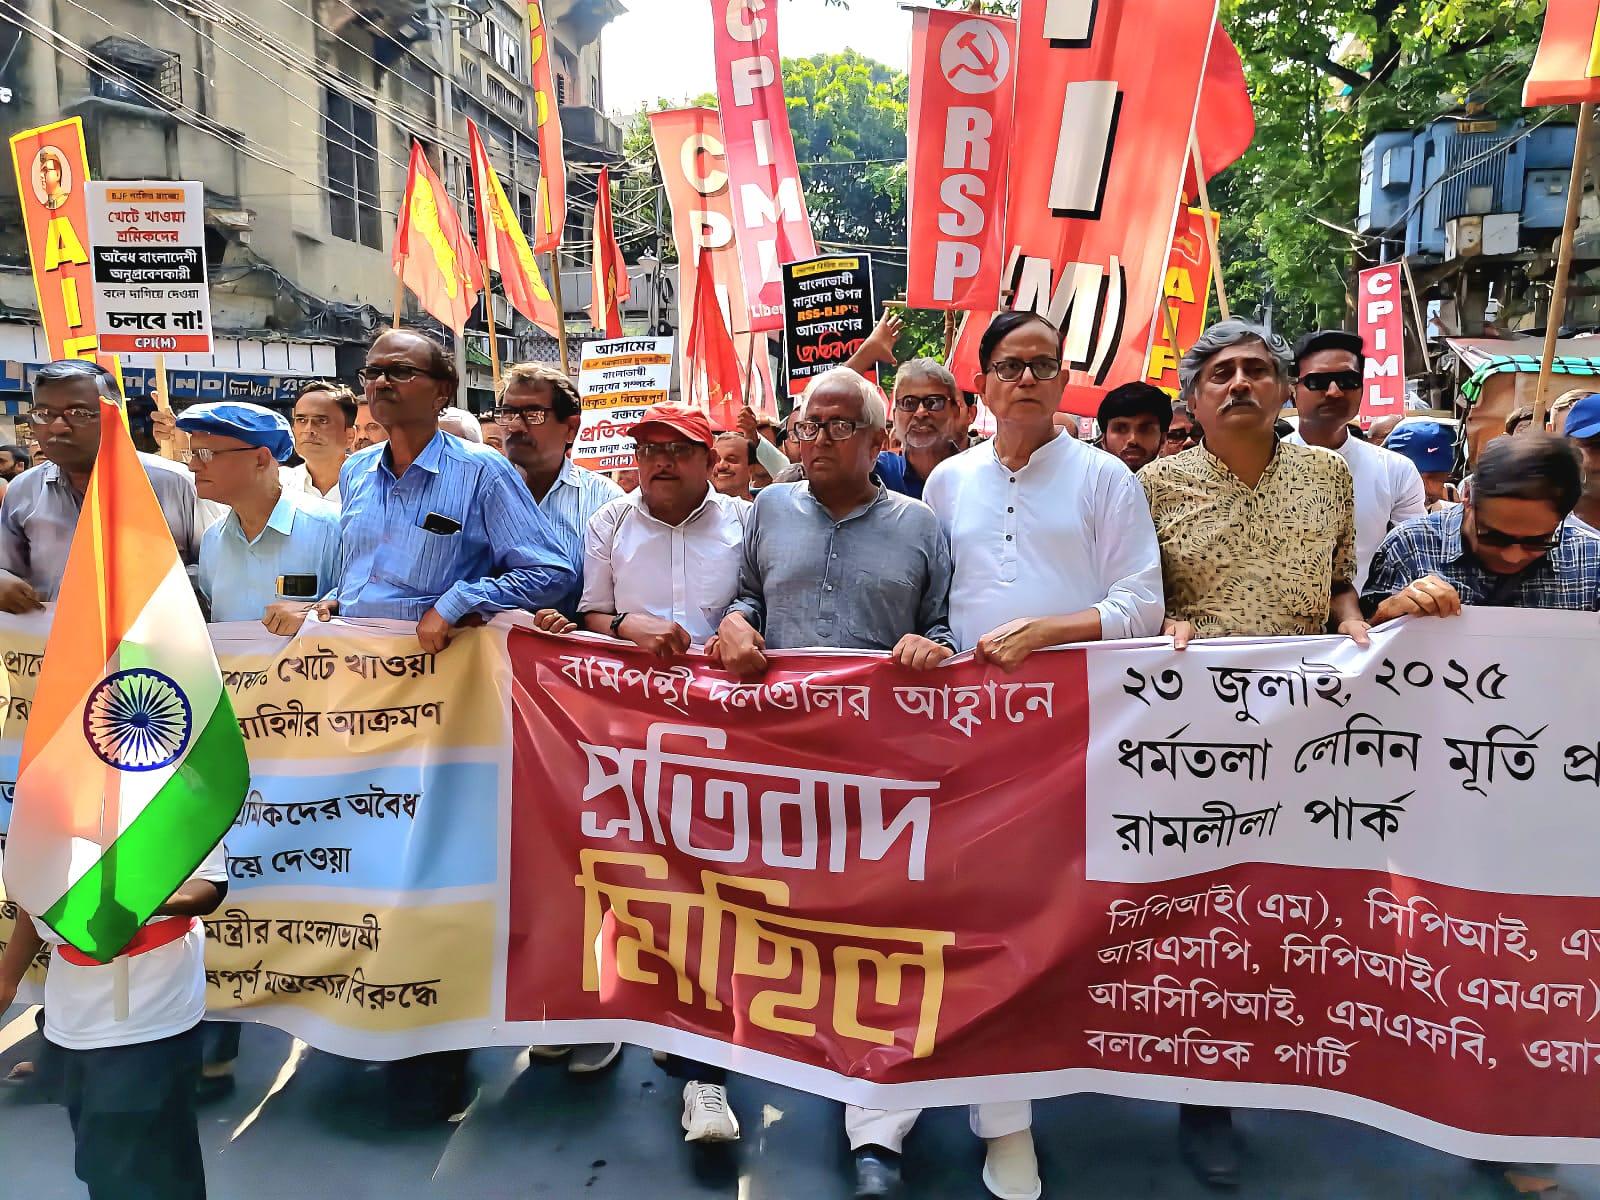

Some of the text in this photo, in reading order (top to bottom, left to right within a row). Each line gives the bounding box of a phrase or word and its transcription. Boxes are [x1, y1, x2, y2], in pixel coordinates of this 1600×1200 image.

[108, 208, 186, 224] খেটে খাওয়া
[933, 106, 993, 301] RSP
[116, 226, 179, 243] শ্রমিকদের
[100, 248, 198, 264] অবৈধ বাংলাদেশী
[109, 266, 191, 283] অনুপ্রবেশকারী
[103, 289, 126, 299] বলে
[167, 289, 199, 299] দেওয়া
[106, 310, 203, 330] চলবে না!
[1364, 272, 1399, 406] CPIML
[134, 337, 177, 349] CPI(M)
[595, 341, 657, 355] আসামের
[278, 646, 338, 682] খেটে
[345, 652, 437, 679] খাওয়া
[1123, 665, 1184, 706] ২৩
[1376, 658, 1509, 704] ২০২৫
[560, 654, 1056, 737] বামপন্থী দলগুলির আহ্বানে
[326, 701, 444, 736] আক্রমণ
[1117, 723, 1273, 781] ধর্মতলা
[1294, 712, 1422, 774] লেনিন
[1443, 723, 1550, 797] মূর্তি
[345, 784, 422, 822] অবৈধ
[577, 722, 941, 882] প্রতিবাদ
[1112, 790, 1416, 856] রামলীলা পার্ক
[272, 847, 352, 873] দেওয়া
[276, 913, 381, 952] বাংলাভাষী
[1364, 887, 1538, 962] সিপিআই,
[574, 848, 956, 1059] মিছিল
[1097, 927, 1260, 974] আরএসপি,
[346, 967, 441, 1010] বিরুদ্ধে
[1087, 974, 1304, 1026] আরসিপিআই,
[1327, 1000, 1497, 1070] এমএফবি,
[1083, 1027, 1361, 1077] বলশেভিক পার্টি
